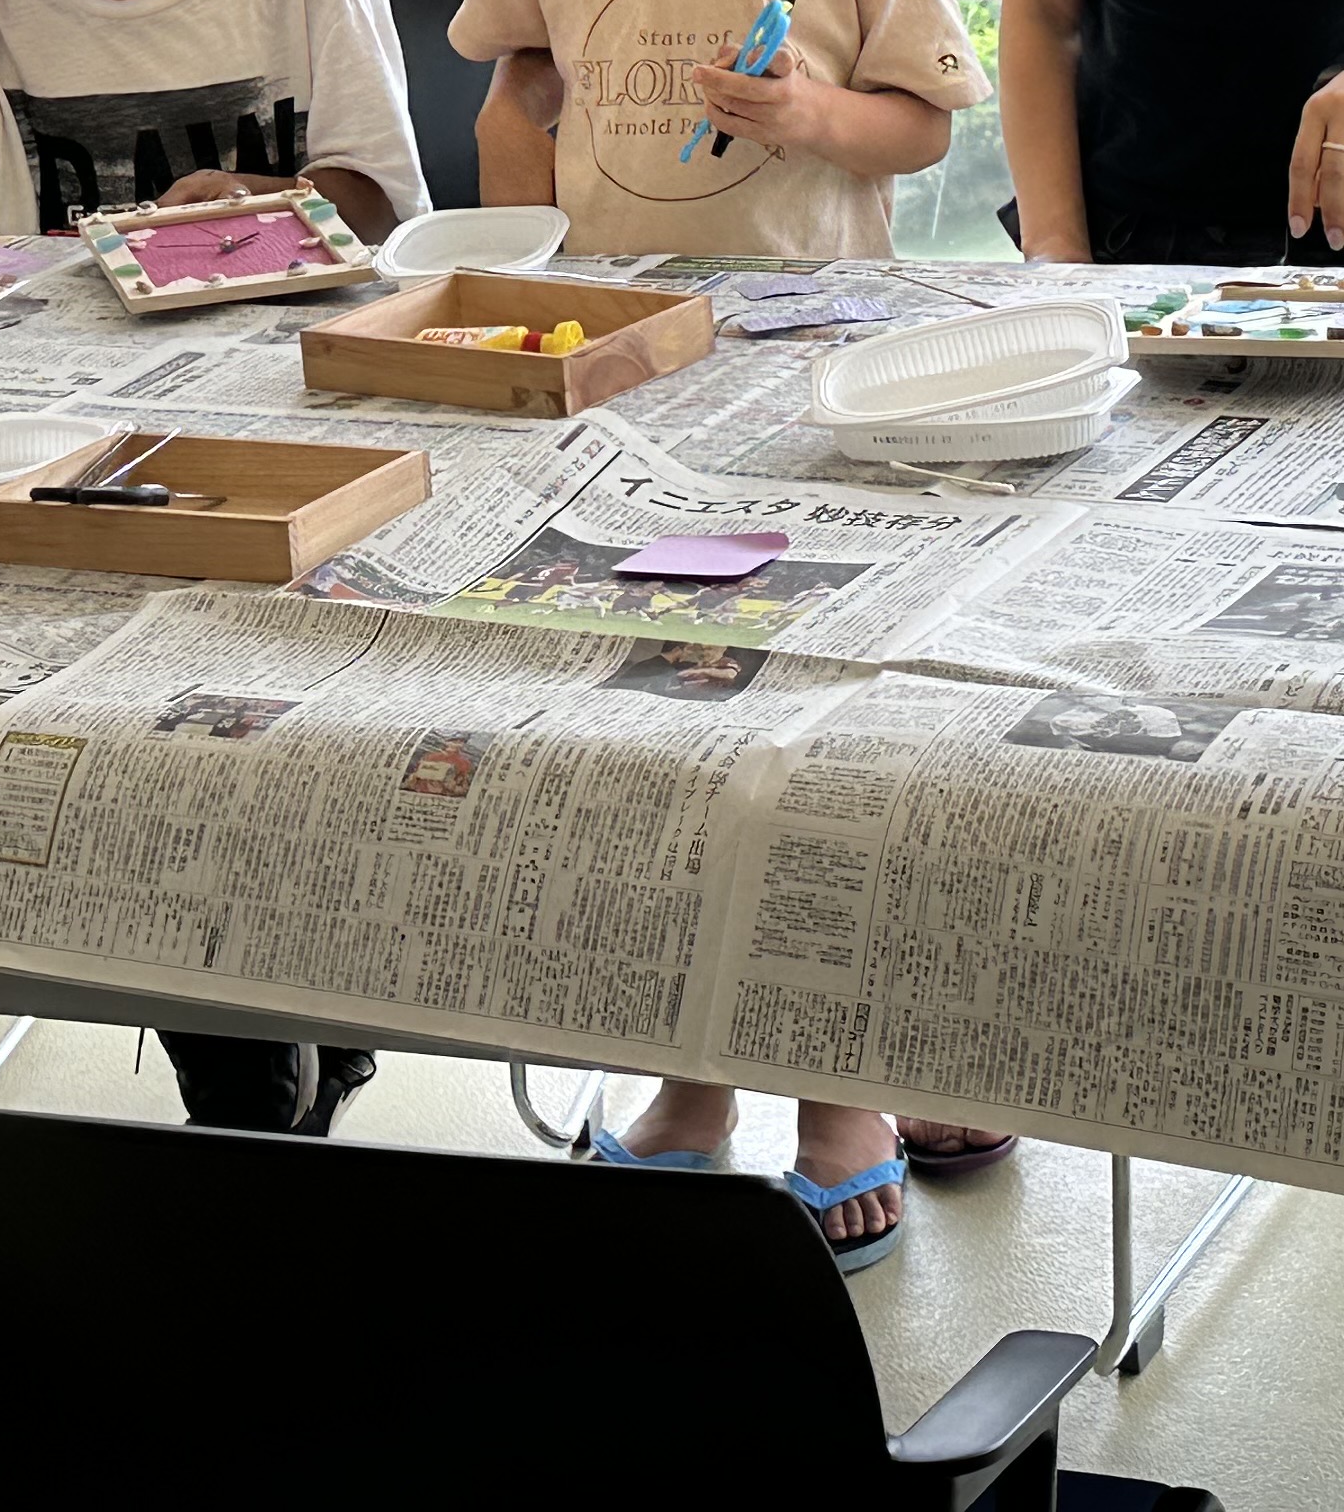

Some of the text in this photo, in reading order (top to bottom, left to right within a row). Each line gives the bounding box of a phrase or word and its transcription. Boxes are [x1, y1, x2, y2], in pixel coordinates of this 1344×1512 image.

[637, 29, 733, 45] State of
[605, 118, 671, 136] Arnold
[619, 477, 801, 516] イニエスタ
